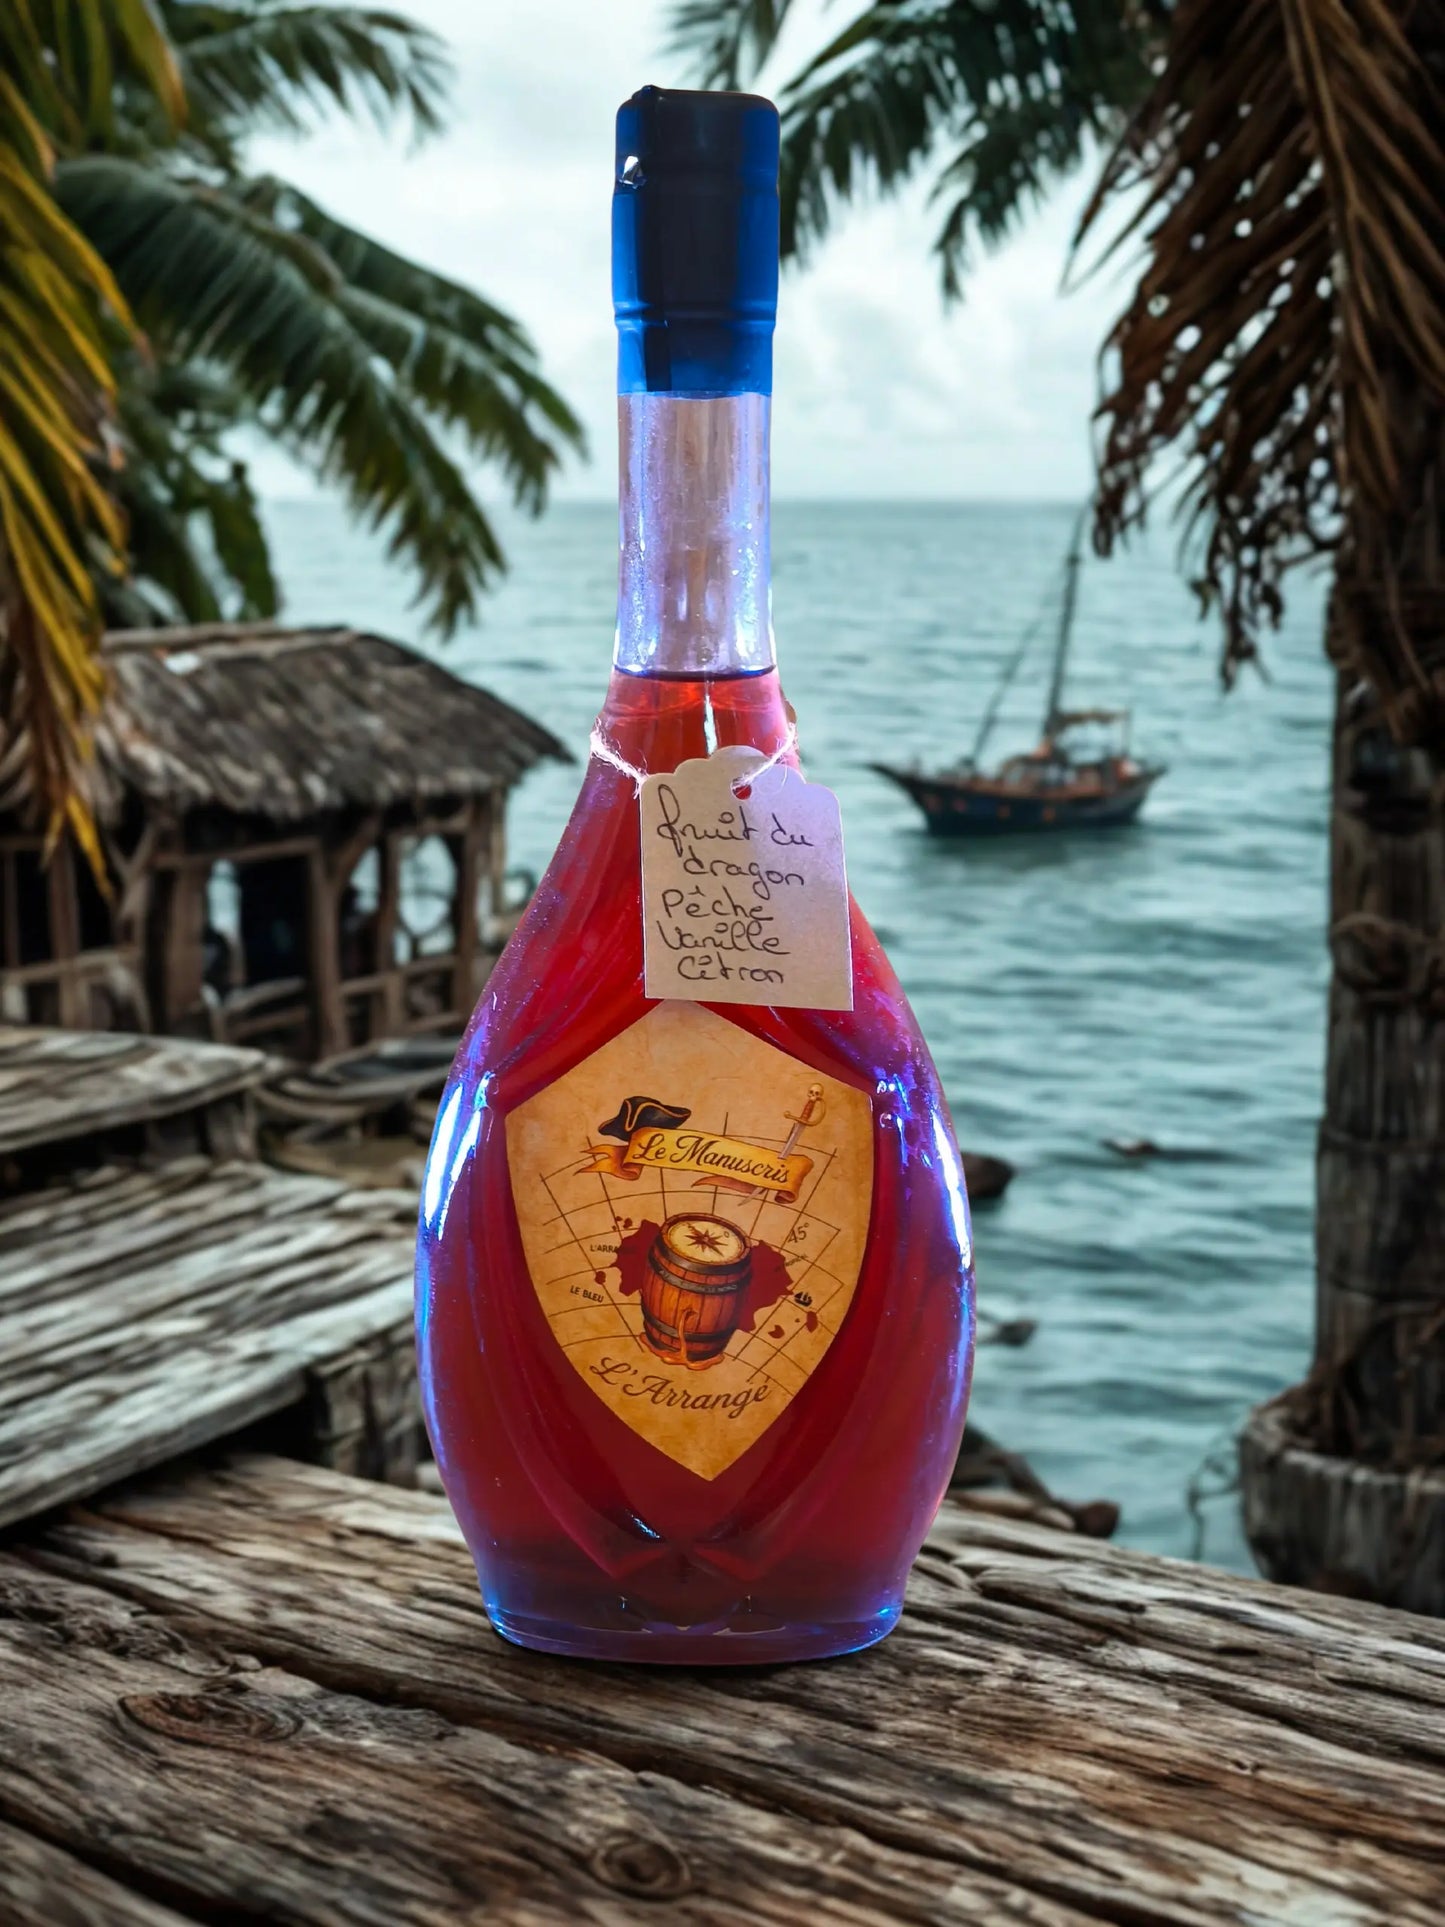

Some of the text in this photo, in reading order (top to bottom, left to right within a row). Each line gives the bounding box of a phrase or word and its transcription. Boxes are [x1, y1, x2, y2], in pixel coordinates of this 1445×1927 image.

[657, 784, 814, 857] fruit du
[683, 845, 805, 900] dragon
[632, 1133, 790, 1184] Le Manuscris
[590, 1244, 638, 1255] L'ARRA
[570, 1285, 604, 1303] LE BLEU
[589, 1357, 773, 1419] L'Arrangé
